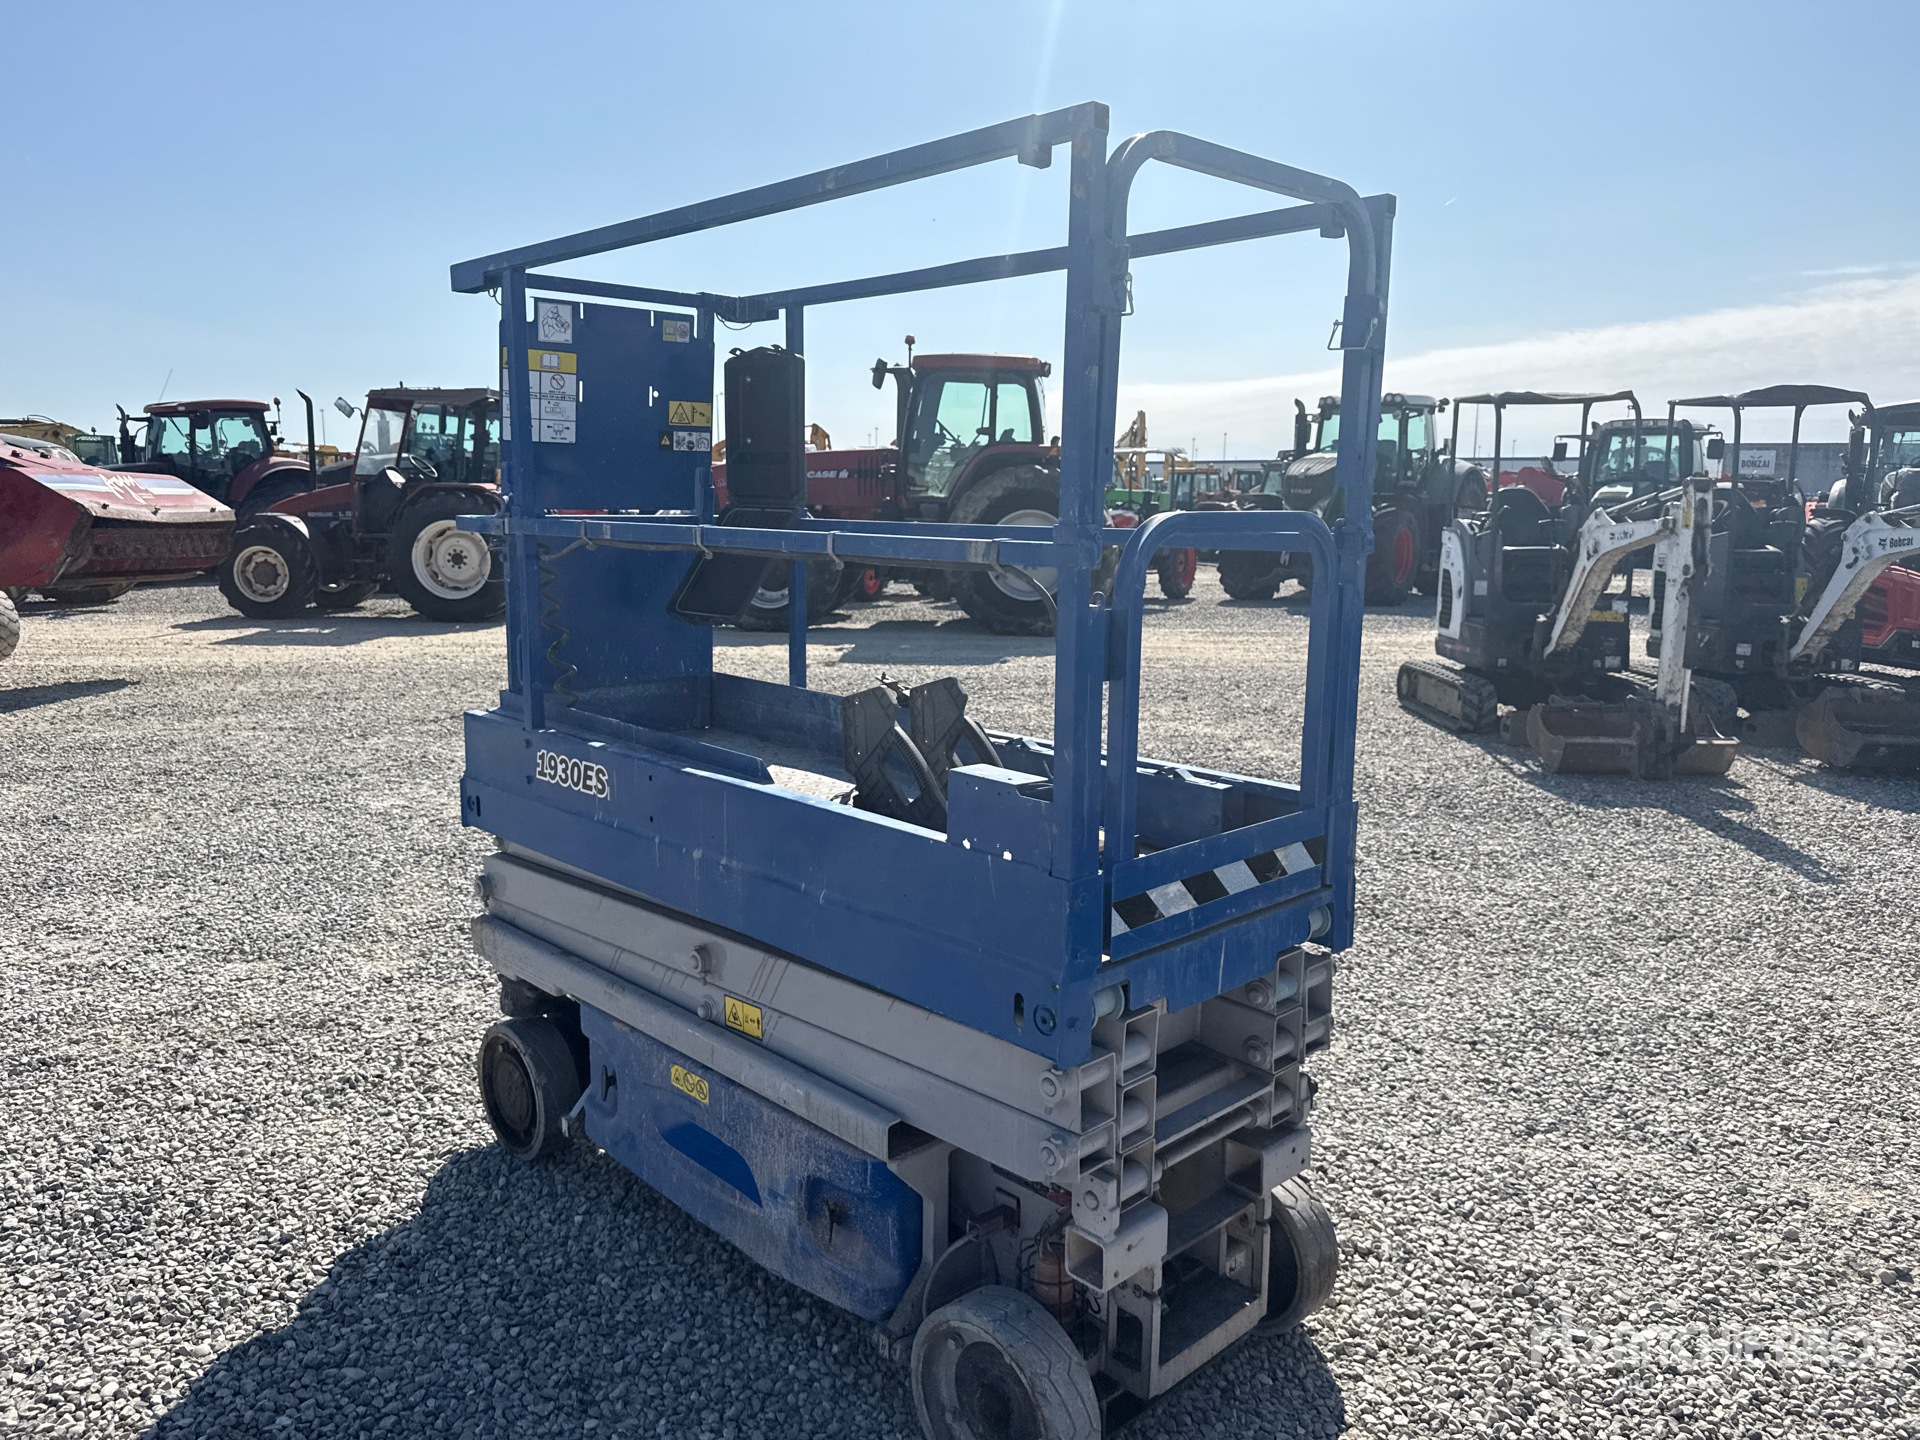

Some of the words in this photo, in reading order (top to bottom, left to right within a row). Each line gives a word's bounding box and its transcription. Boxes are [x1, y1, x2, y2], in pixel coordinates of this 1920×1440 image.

[1741, 460, 1770, 468] BONZAI
[806, 470, 838, 479] CASE
[1889, 536, 1914, 549] Bobcat
[536, 749, 608, 799] 1930ES
